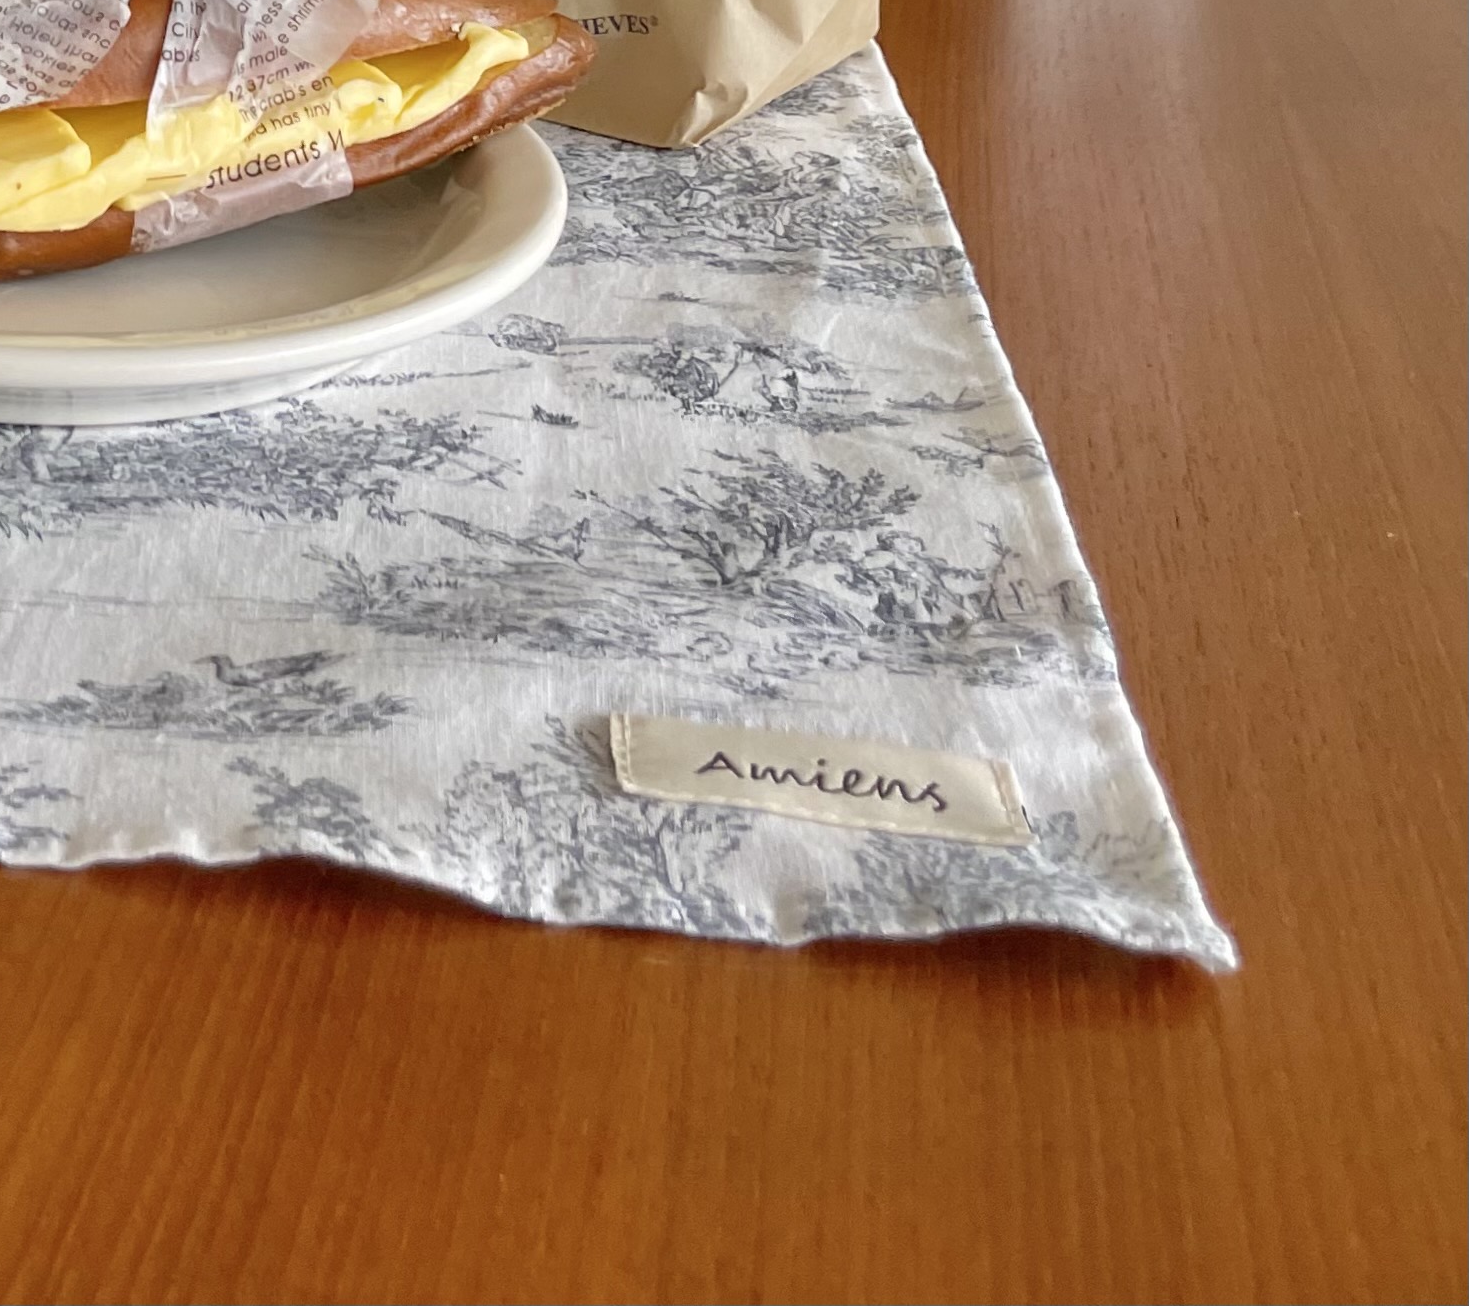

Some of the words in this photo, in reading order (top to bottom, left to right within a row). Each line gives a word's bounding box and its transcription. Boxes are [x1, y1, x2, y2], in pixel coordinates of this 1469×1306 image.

[249, 45, 288, 69] male
[260, 83, 307, 112] crab's
[270, 111, 300, 131] has
[694, 750, 949, 813] Amiens
